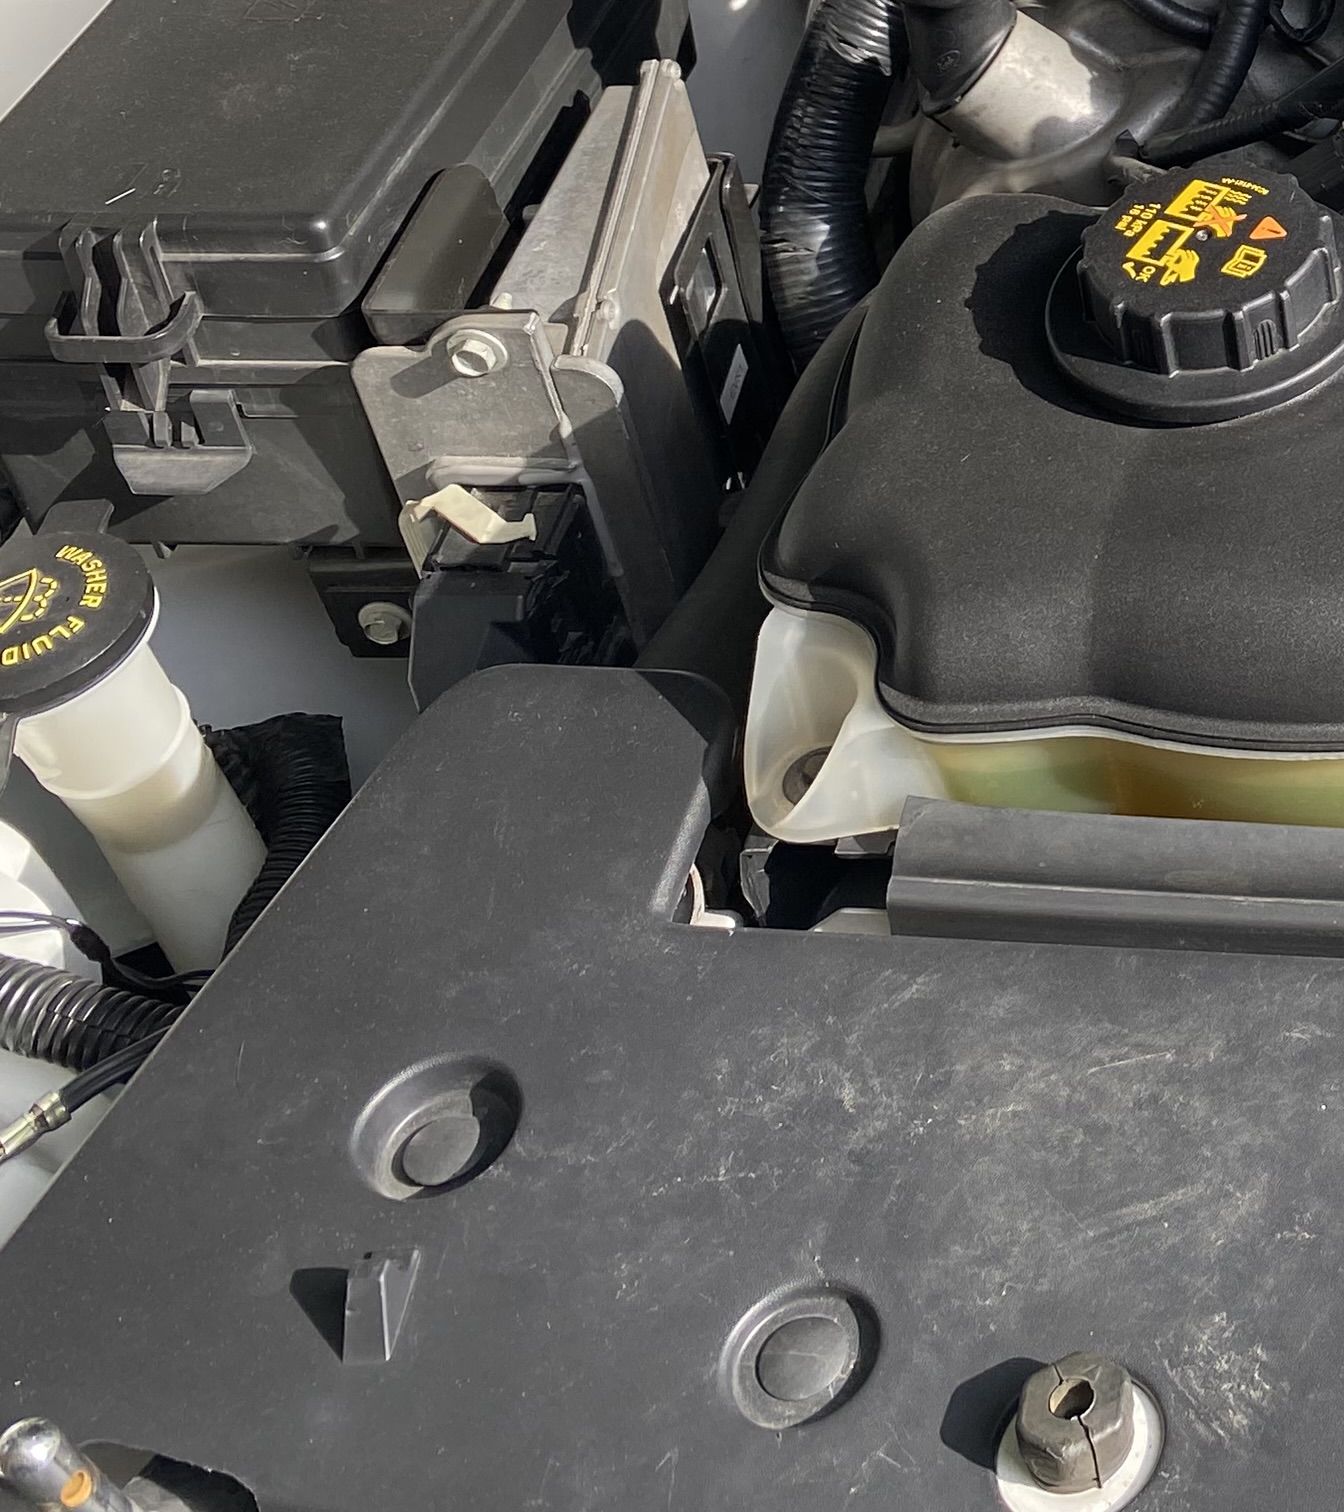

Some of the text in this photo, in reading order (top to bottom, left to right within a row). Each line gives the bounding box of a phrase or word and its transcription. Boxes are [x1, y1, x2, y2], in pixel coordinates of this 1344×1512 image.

[1136, 265, 1156, 283] OK
[55, 545, 107, 608] WASHER
[2, 616, 85, 665] FLUID
